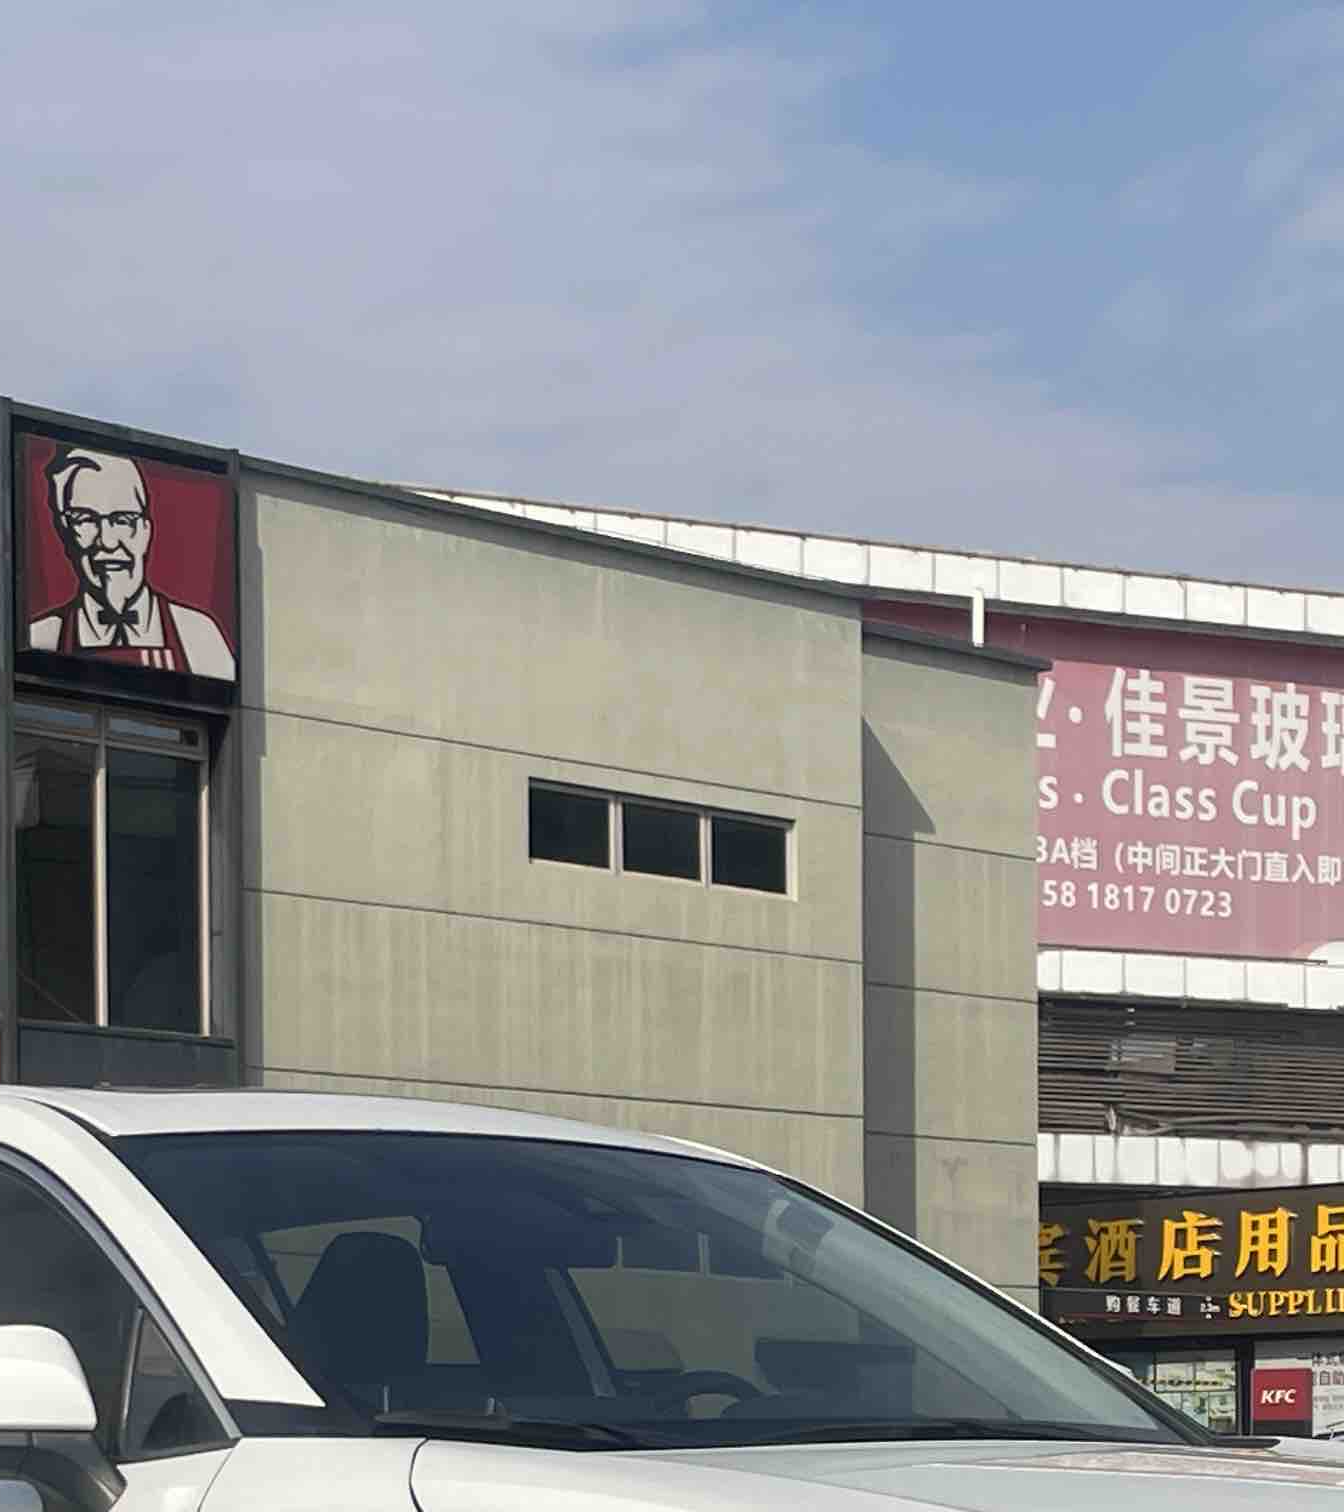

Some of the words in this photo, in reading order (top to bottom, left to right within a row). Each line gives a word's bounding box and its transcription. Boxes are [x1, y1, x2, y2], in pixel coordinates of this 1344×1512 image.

[1102, 769, 1217, 822] Class
[1231, 779, 1317, 841] Cup
[1087, 882, 1155, 912] 1817
[1164, 888, 1233, 918] 0723
[1260, 1388, 1298, 1405] KFC
